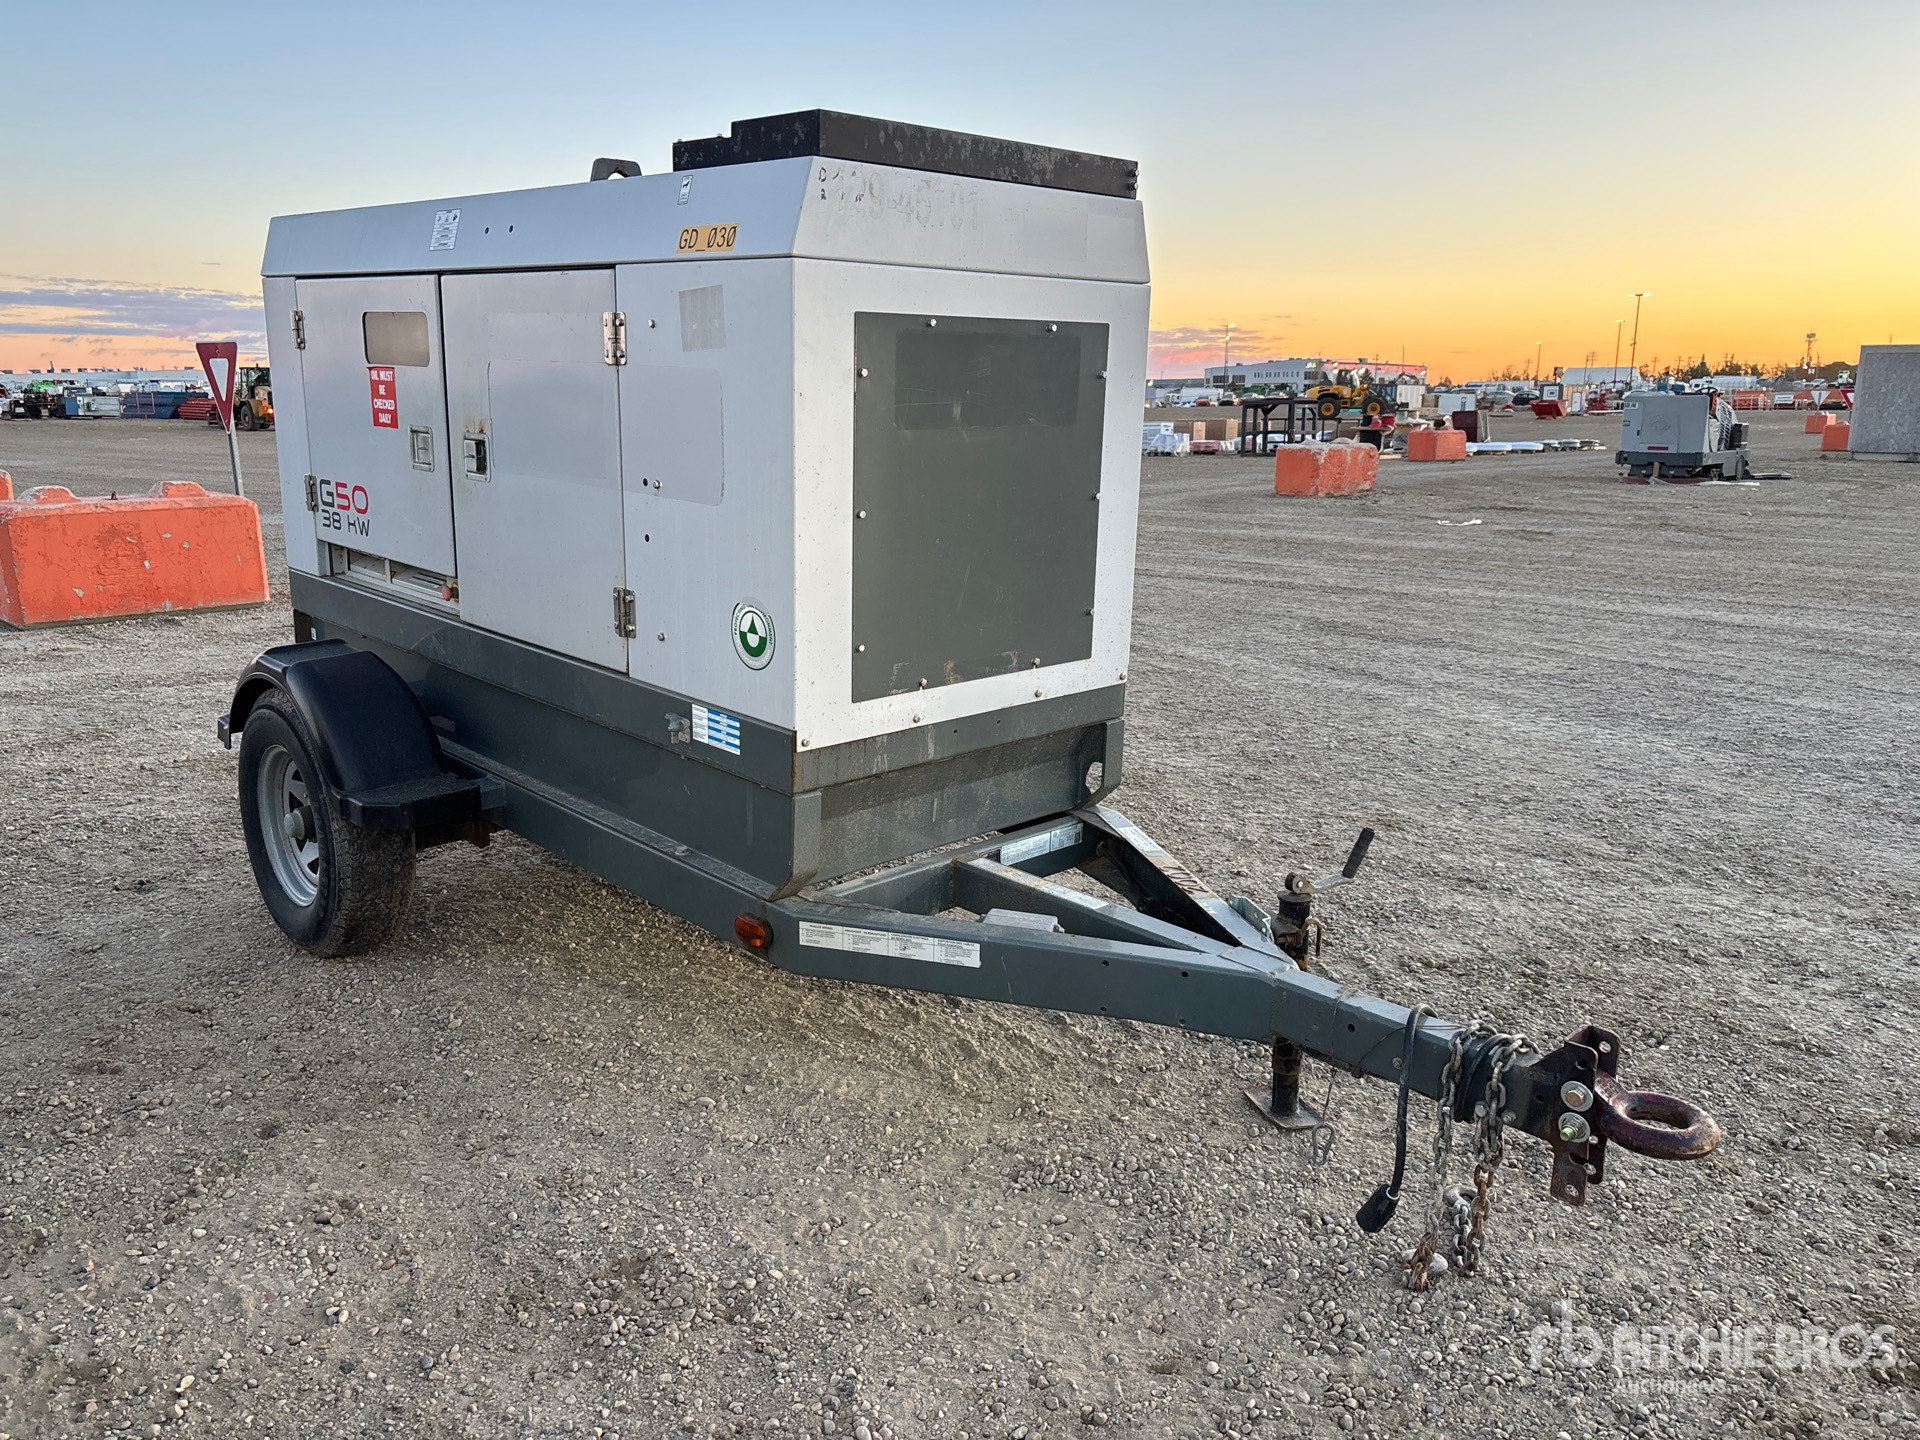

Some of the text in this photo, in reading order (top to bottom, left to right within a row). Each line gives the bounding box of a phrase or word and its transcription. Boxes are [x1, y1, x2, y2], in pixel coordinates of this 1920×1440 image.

[371, 369, 393, 381] OIL MUST
[379, 384, 386, 395] BE
[373, 398, 395, 410] CHECKED
[378, 412, 391, 424] DAILY
[320, 478, 369, 515] G50
[321, 509, 341, 531] 38
